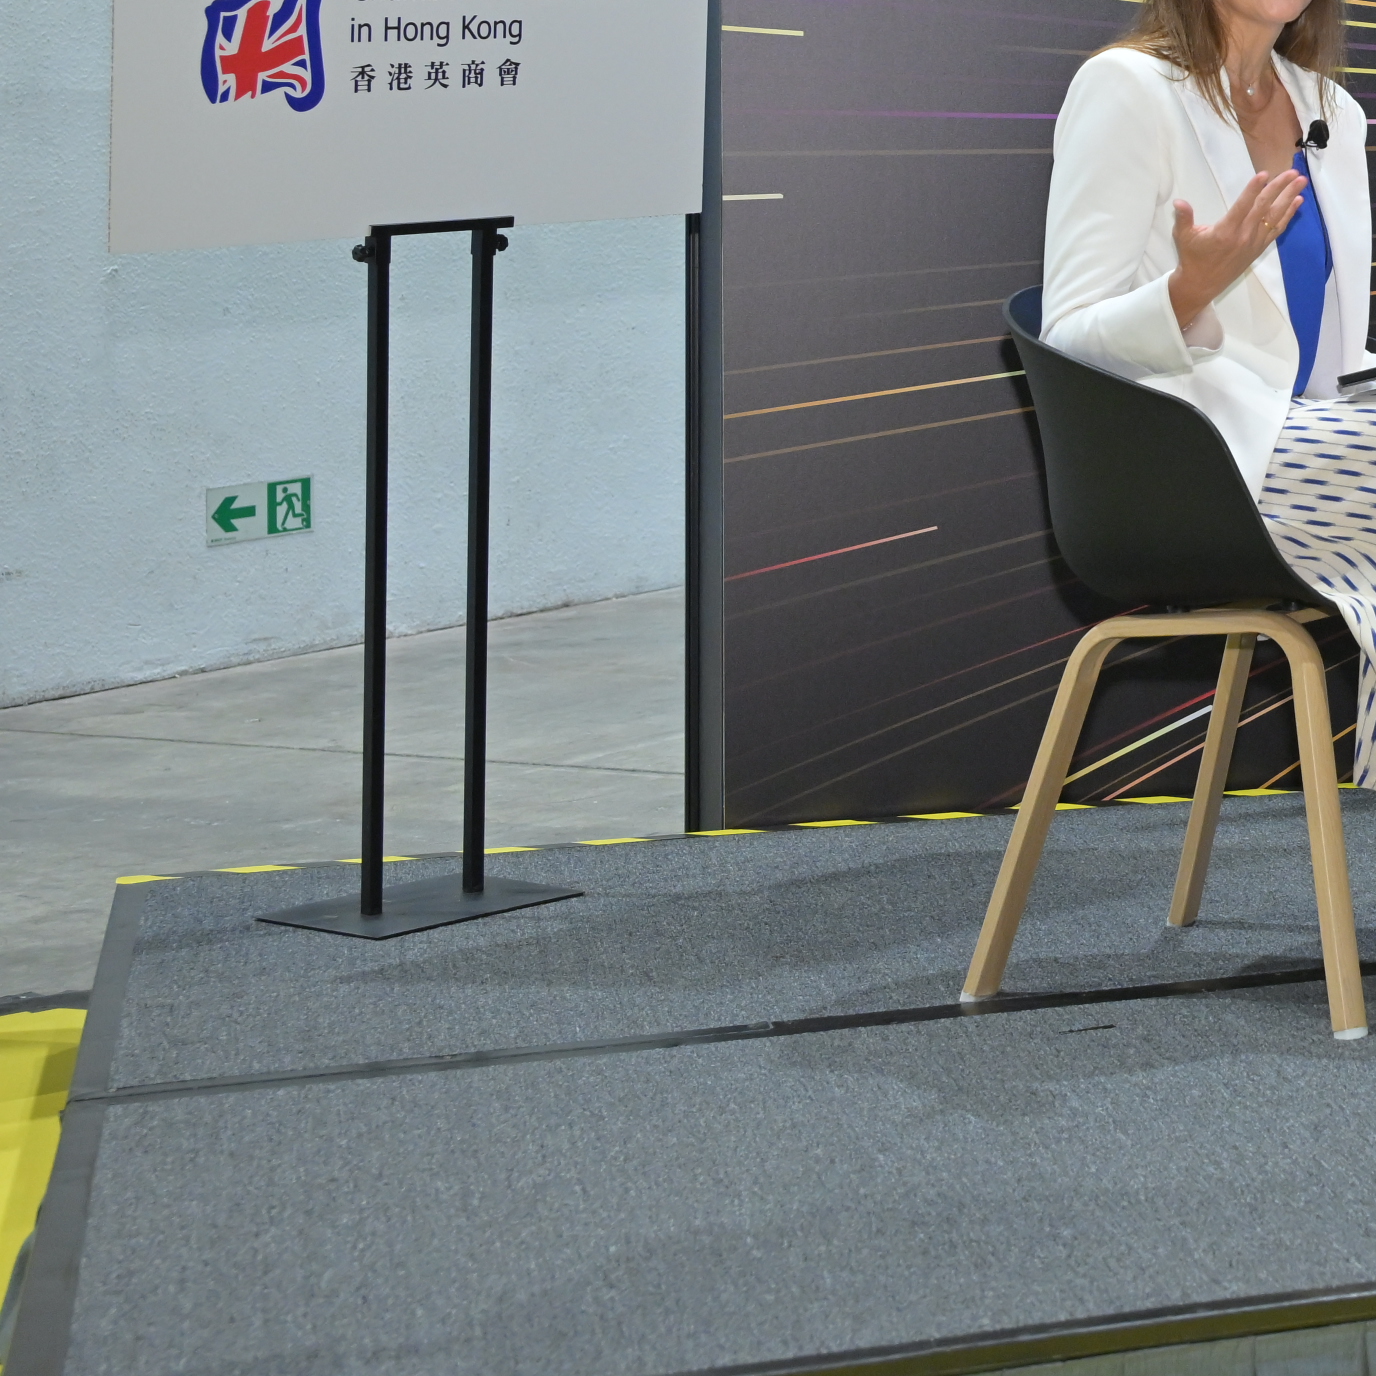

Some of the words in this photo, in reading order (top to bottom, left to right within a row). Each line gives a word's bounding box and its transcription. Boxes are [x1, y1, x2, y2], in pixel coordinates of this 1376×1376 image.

[350, 17, 372, 43] in
[383, 17, 451, 48] Hong
[461, 15, 523, 45] Kong
[349, 57, 522, 94] 香港英商會
